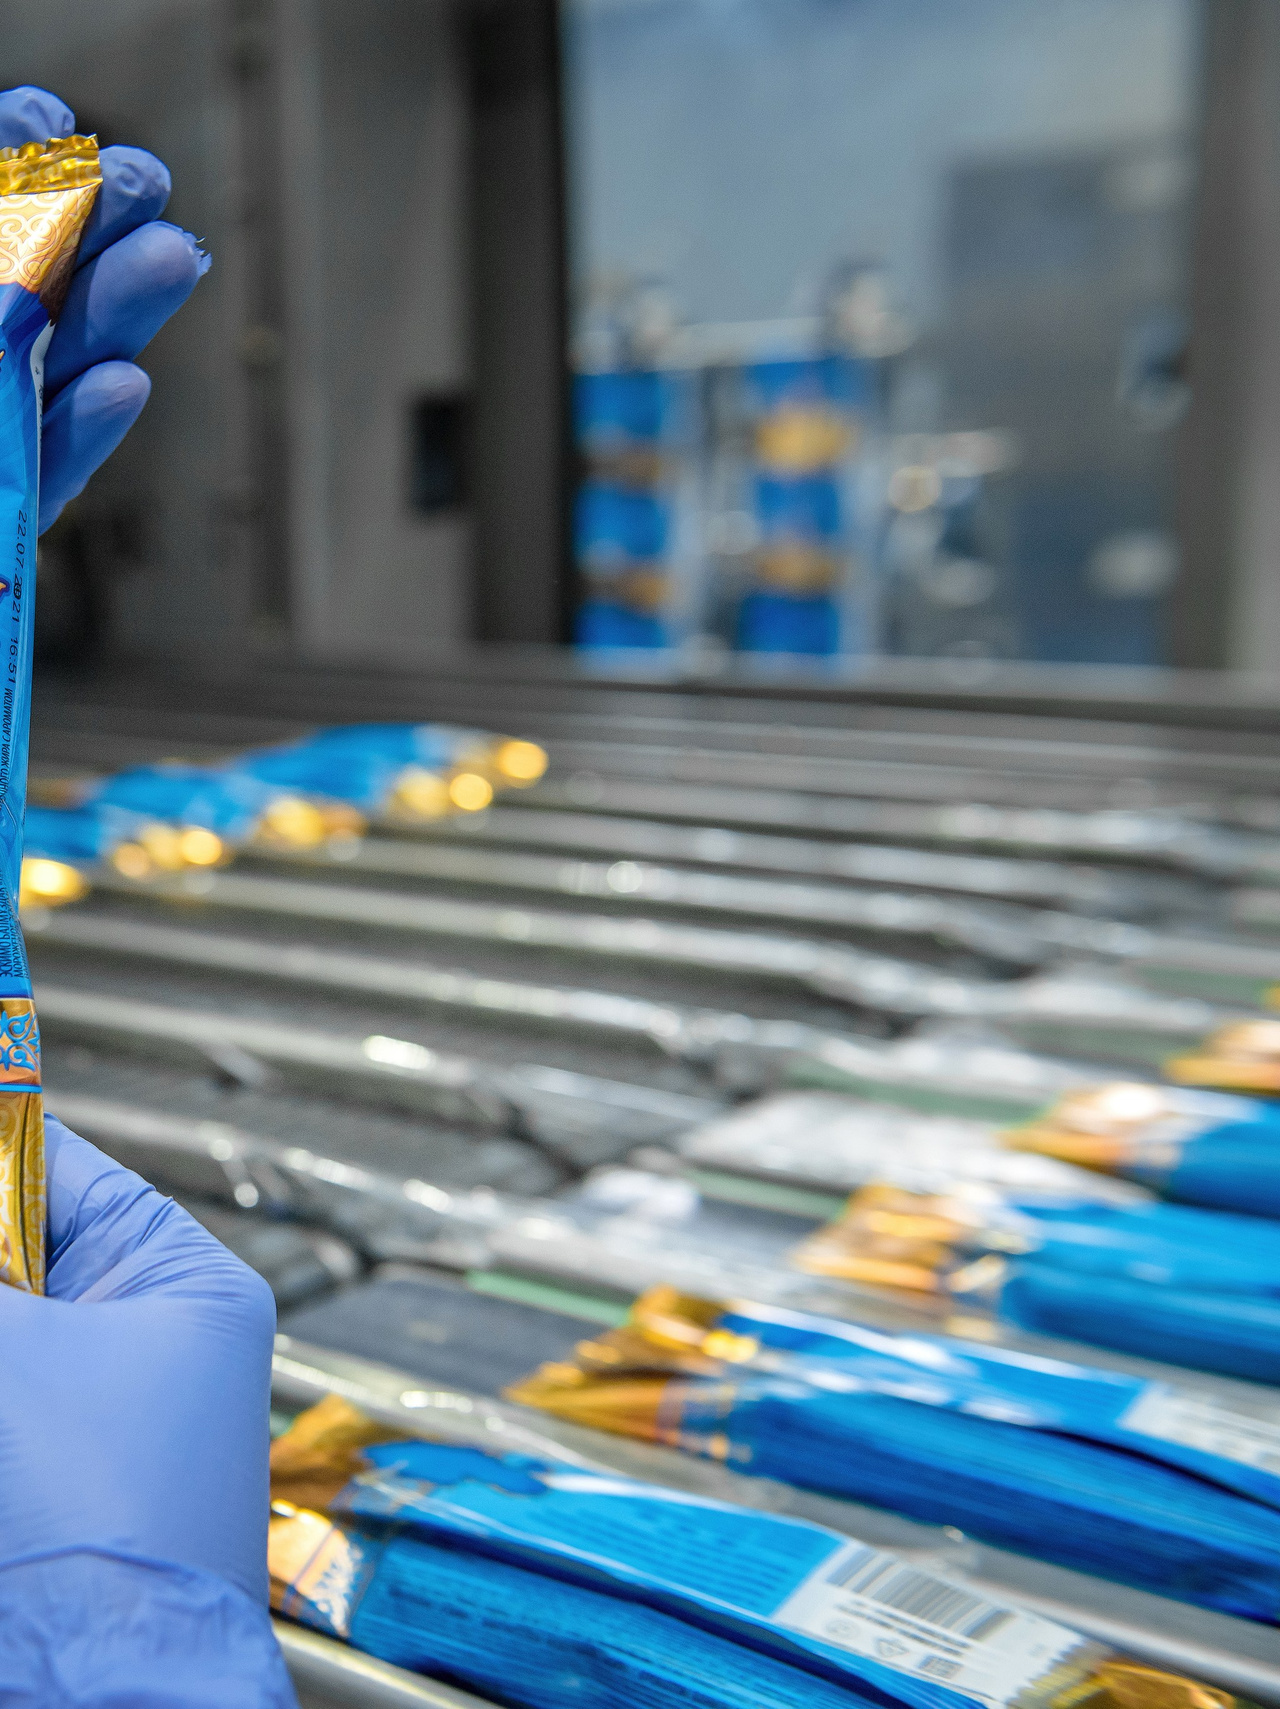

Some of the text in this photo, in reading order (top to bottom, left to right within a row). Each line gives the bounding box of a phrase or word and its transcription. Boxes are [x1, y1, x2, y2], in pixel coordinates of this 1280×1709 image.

[7, 637, 20, 684] 16:51
[1, 688, 14, 736] АРОМАТОМ
[0, 743, 11, 768] ЖИРА
[1, 735, 11, 743] С
